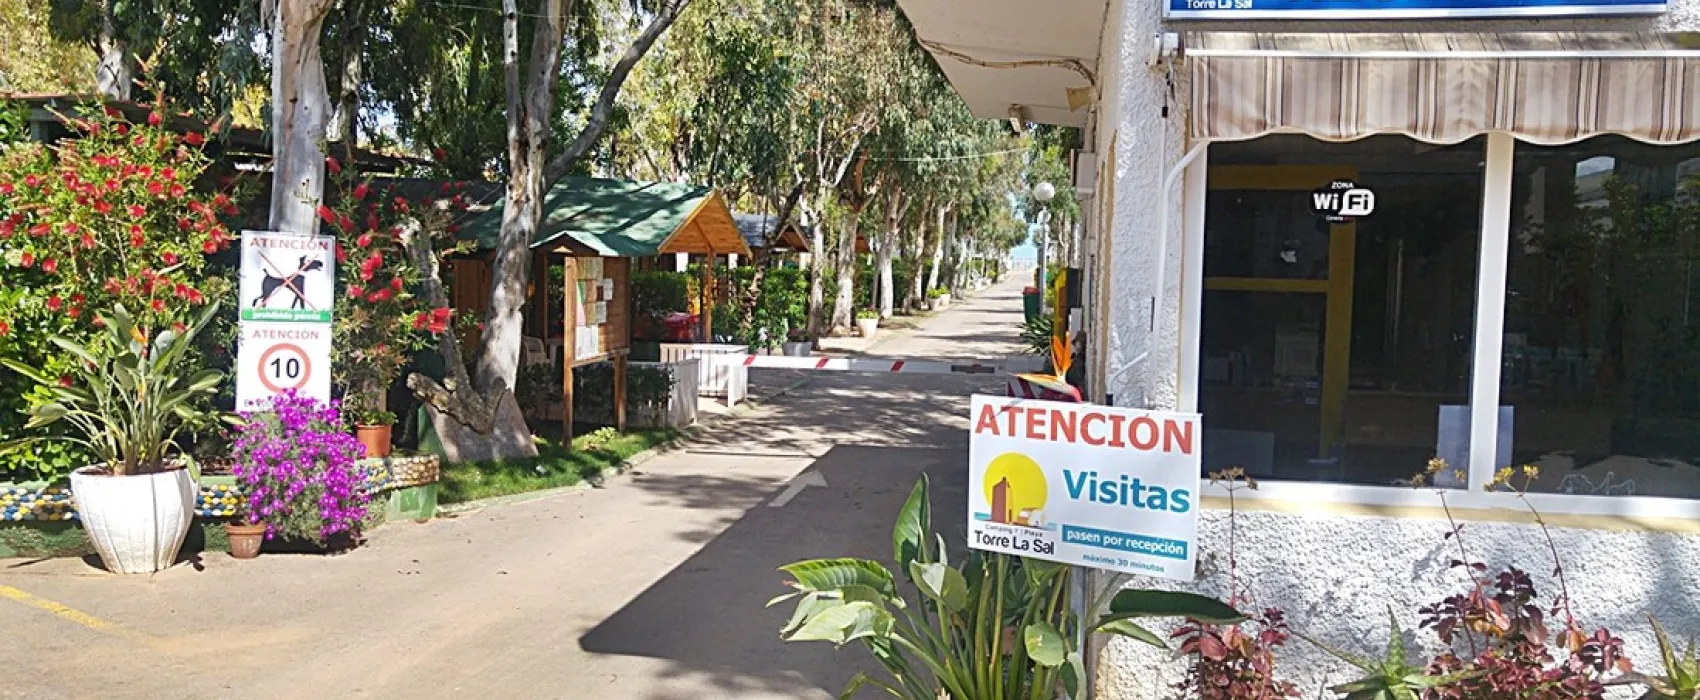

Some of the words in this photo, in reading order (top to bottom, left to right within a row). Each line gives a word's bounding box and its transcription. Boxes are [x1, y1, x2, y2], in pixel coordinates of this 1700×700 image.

[1218, 0, 1232, 9] La
[1331, 181, 1354, 190] ZONA
[253, 328, 320, 340] ATENCIÓN
[270, 358, 300, 379] 10
[1062, 469, 1190, 514] Visitas
[974, 529, 1010, 548] Torre
[1013, 536, 1030, 551] La
[1033, 539, 1055, 555] Sal
[1067, 530, 1100, 543] pasen
[1103, 534, 1123, 546] por
[1125, 537, 1184, 555] recepción
[1083, 553, 1116, 565] máximo
[1118, 558, 1129, 567] 30
[1130, 560, 1165, 573] minutos
